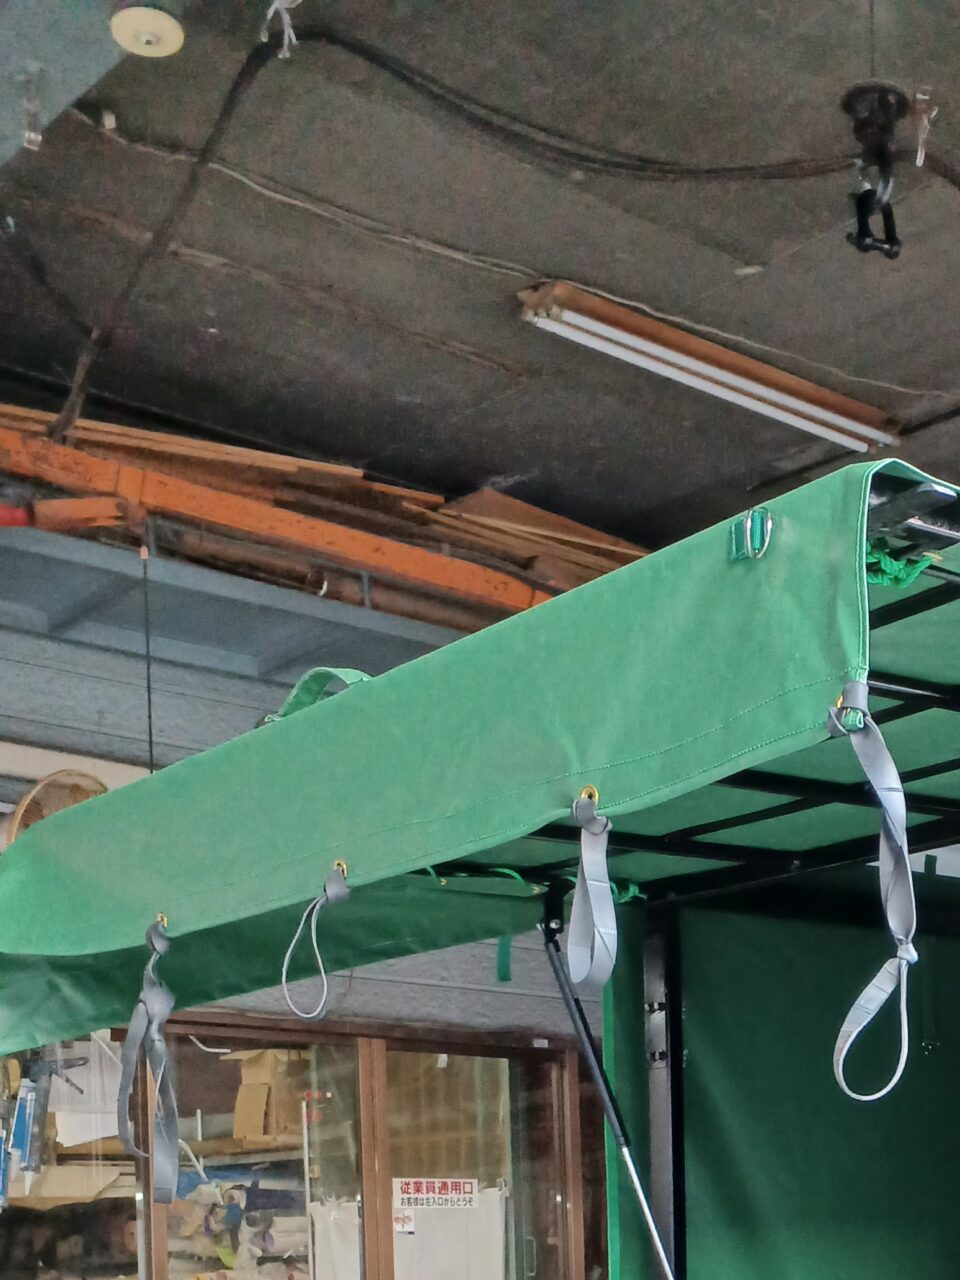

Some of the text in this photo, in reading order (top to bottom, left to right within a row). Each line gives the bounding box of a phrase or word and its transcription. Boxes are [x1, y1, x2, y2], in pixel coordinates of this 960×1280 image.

[400, 1181, 473, 1195] 従業員通用口
